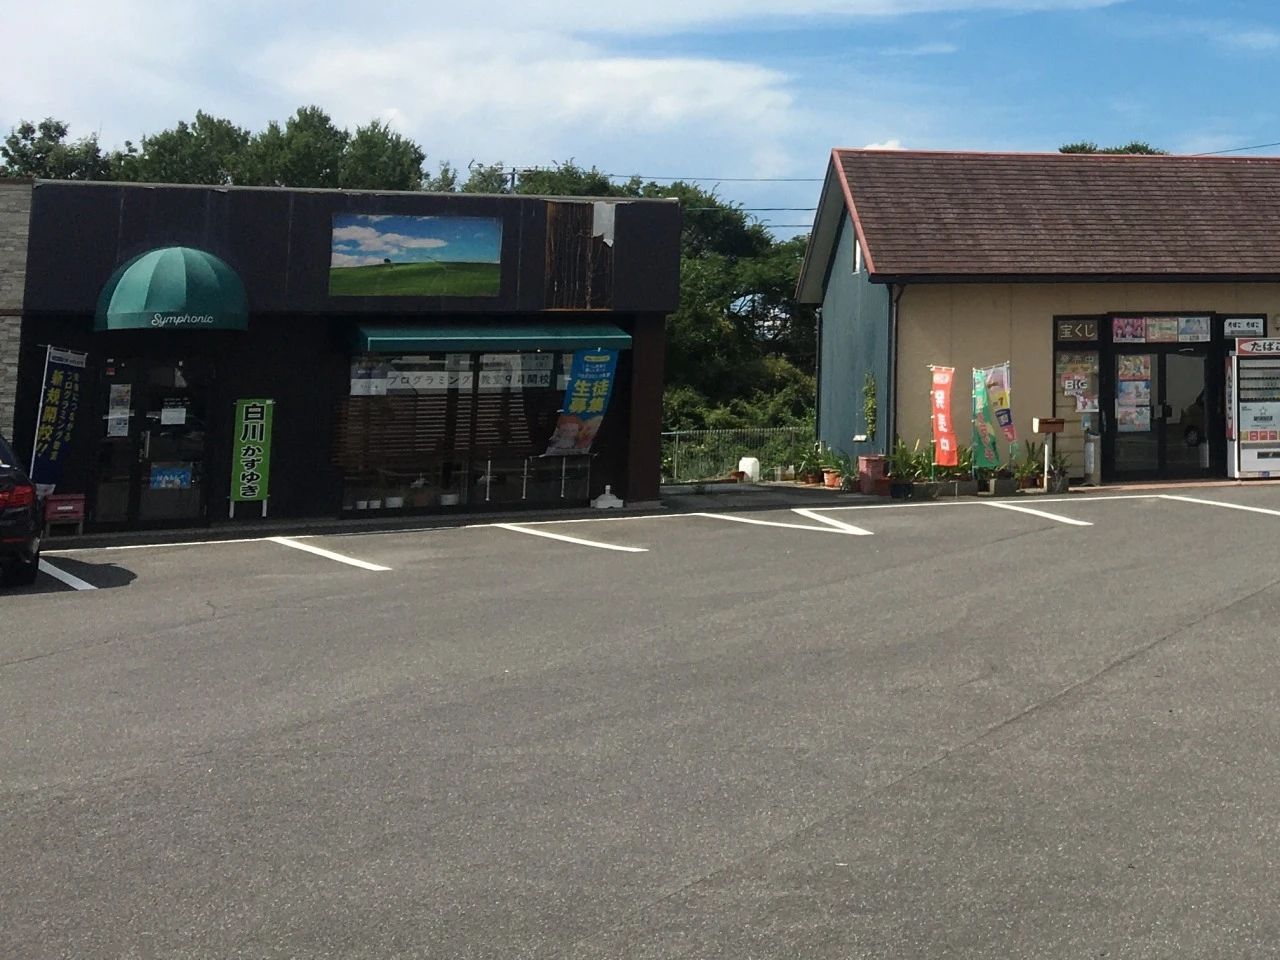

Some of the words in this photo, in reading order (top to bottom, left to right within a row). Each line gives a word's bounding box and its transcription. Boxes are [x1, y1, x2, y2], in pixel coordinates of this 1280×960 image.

[151, 312, 214, 328] Symphonic
[1060, 324, 1096, 339] 宝くじ
[387, 372, 472, 387] プログラミング
